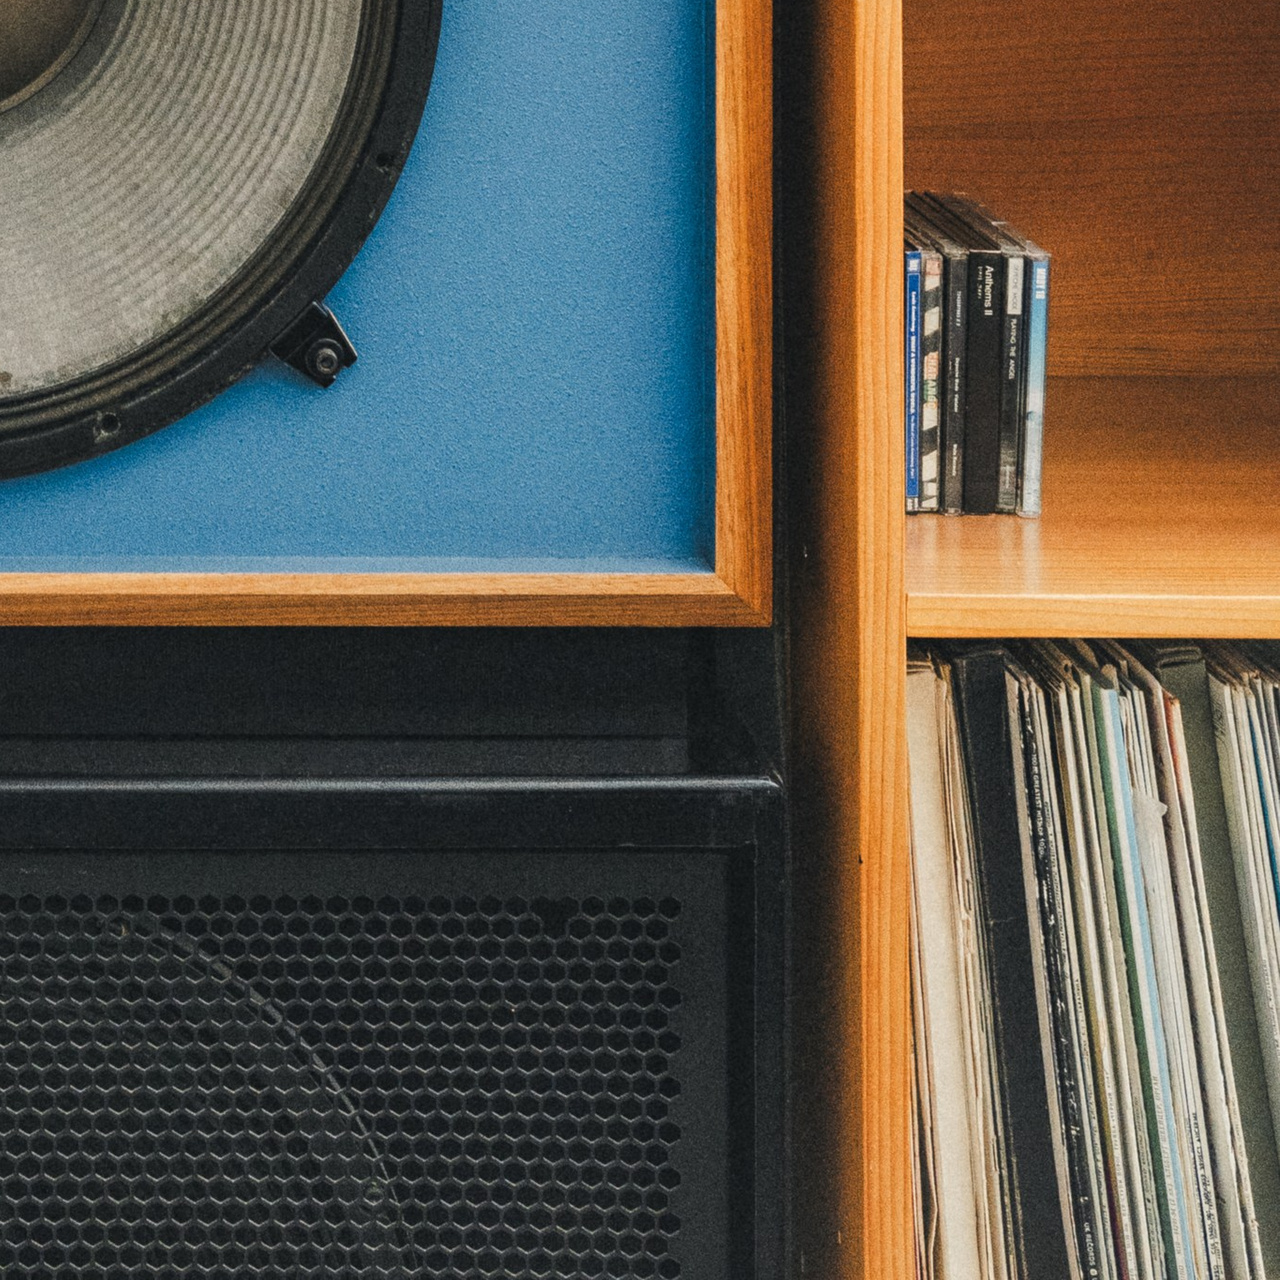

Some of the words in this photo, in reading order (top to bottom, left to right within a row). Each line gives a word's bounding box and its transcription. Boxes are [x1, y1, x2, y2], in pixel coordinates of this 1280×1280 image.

[984, 265, 994, 308] Anthems
[1010, 318, 1018, 344] PLAYING
[1009, 346, 1017, 357] THE
[1008, 360, 1016, 380] ANGEL
[1032, 773, 1041, 808] GREATEST
[1084, 1232, 1097, 1266] RECORDS
